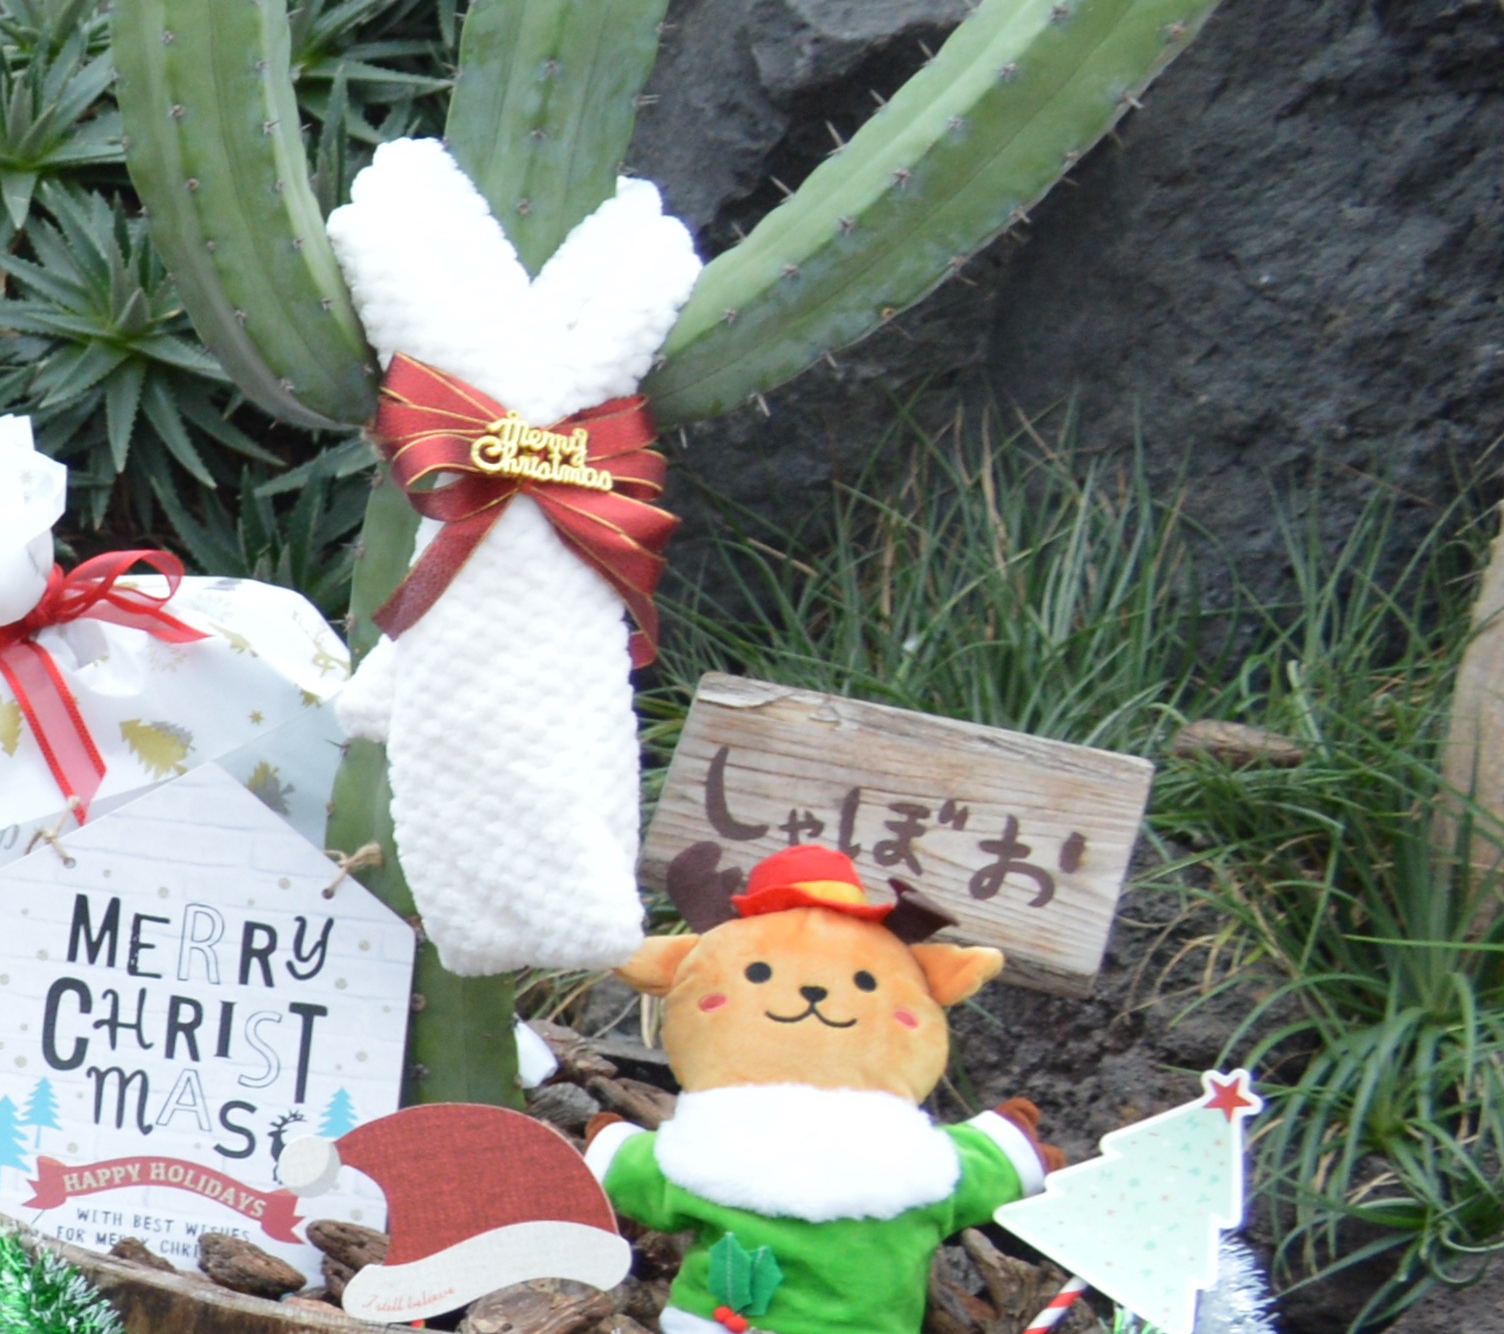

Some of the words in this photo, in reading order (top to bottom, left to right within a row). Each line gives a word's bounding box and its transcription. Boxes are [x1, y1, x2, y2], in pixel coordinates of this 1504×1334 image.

[471, 434, 613, 492] Christmas
[485, 417, 588, 466] Merry
[704, 746, 1087, 908] しゃぼお
[66, 893, 335, 988] MERRY
[41, 976, 329, 1104] CHRIST
[86, 1065, 258, 1160] MAS
[63, 1163, 141, 1193] HAPPY
[149, 1162, 267, 1218] HOLIDAYS
[56, 1225, 86, 1243] FOR
[77, 1208, 123, 1226] WITH
[133, 1214, 175, 1233] BEST
